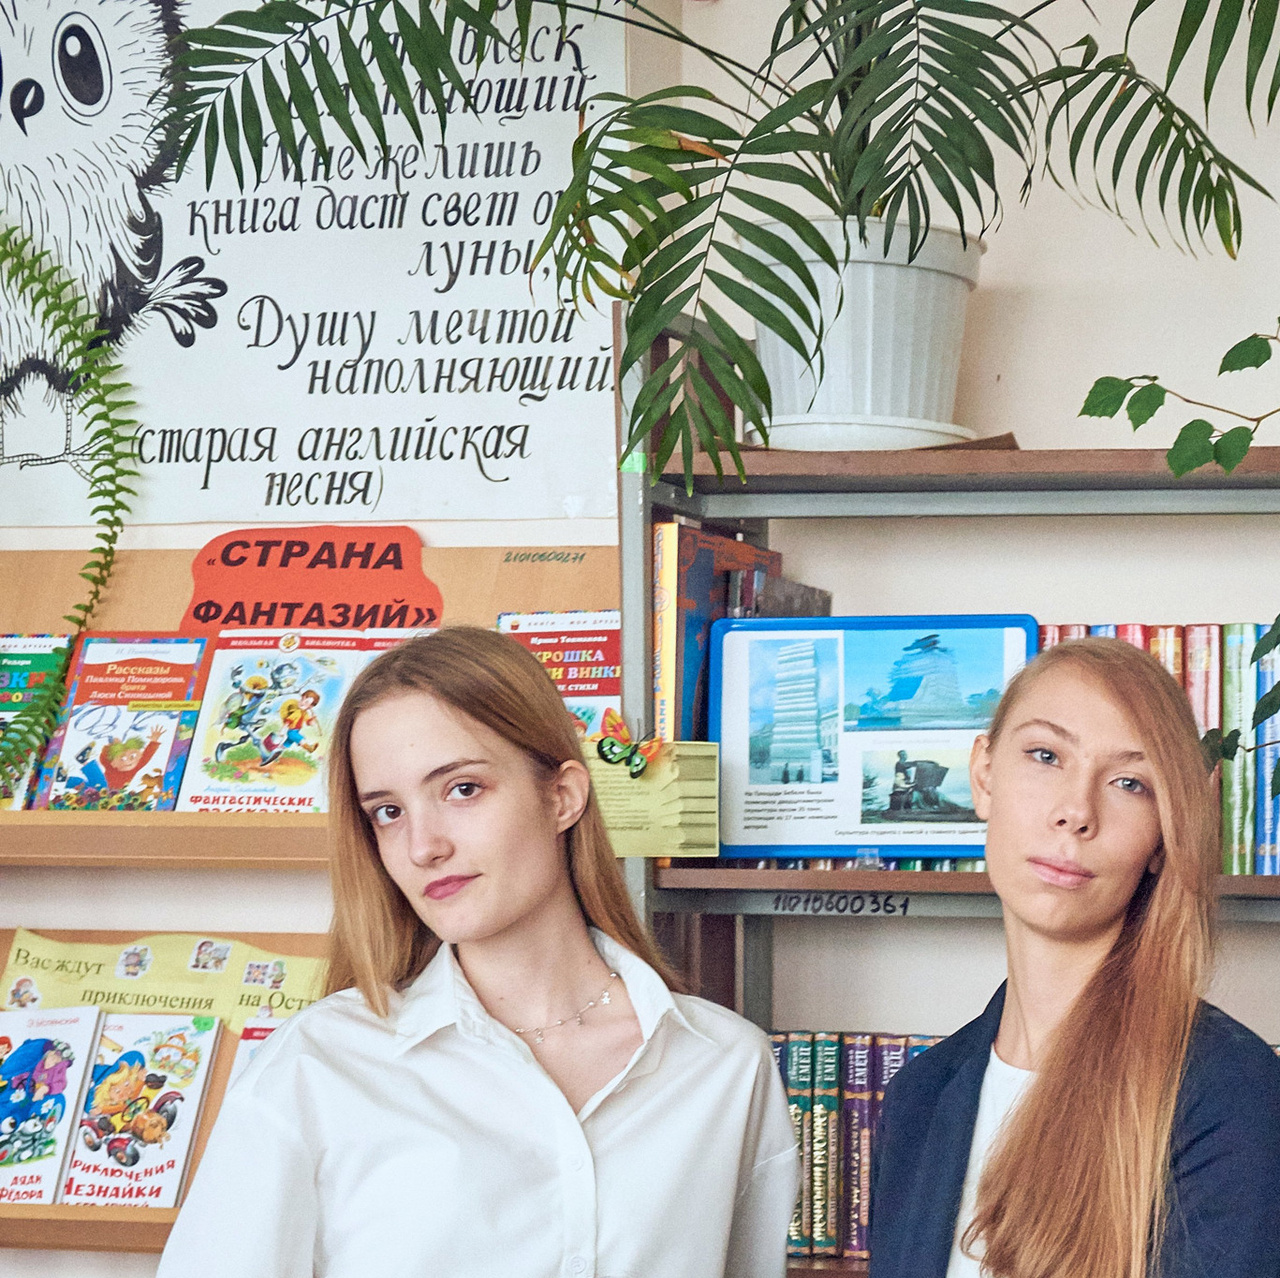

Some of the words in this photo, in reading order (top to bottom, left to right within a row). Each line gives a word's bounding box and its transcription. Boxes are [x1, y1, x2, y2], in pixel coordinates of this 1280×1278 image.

[188, 196, 301, 255] книга
[315, 185, 408, 231] даст
[421, 189, 520, 228] свет
[533, 190, 566, 227] о
[408, 238, 551, 293] луны,
[237, 294, 376, 371] Душу
[397, 297, 578, 345] мечтой
[131, 422, 278, 490] (старая
[297, 415, 532, 482] английская
[264, 465, 385, 513] песня)
[206, 540, 404, 570] «СТРАНА
[192, 599, 437, 629] ФАНТАЗИЙ»
[106, 664, 171, 675] Рассказы
[13, 948, 51, 971] Вас
[55, 958, 105, 981] ждут
[80, 988, 215, 1010] приключения
[238, 992, 261, 1008] на
[798, 1046, 812, 1082] ЕМЕЦ
[824, 1046, 838, 1082] ЕМЕЦ
[855, 1049, 869, 1085] ЕМЕЦ
[889, 1047, 906, 1079] МЕЦ
